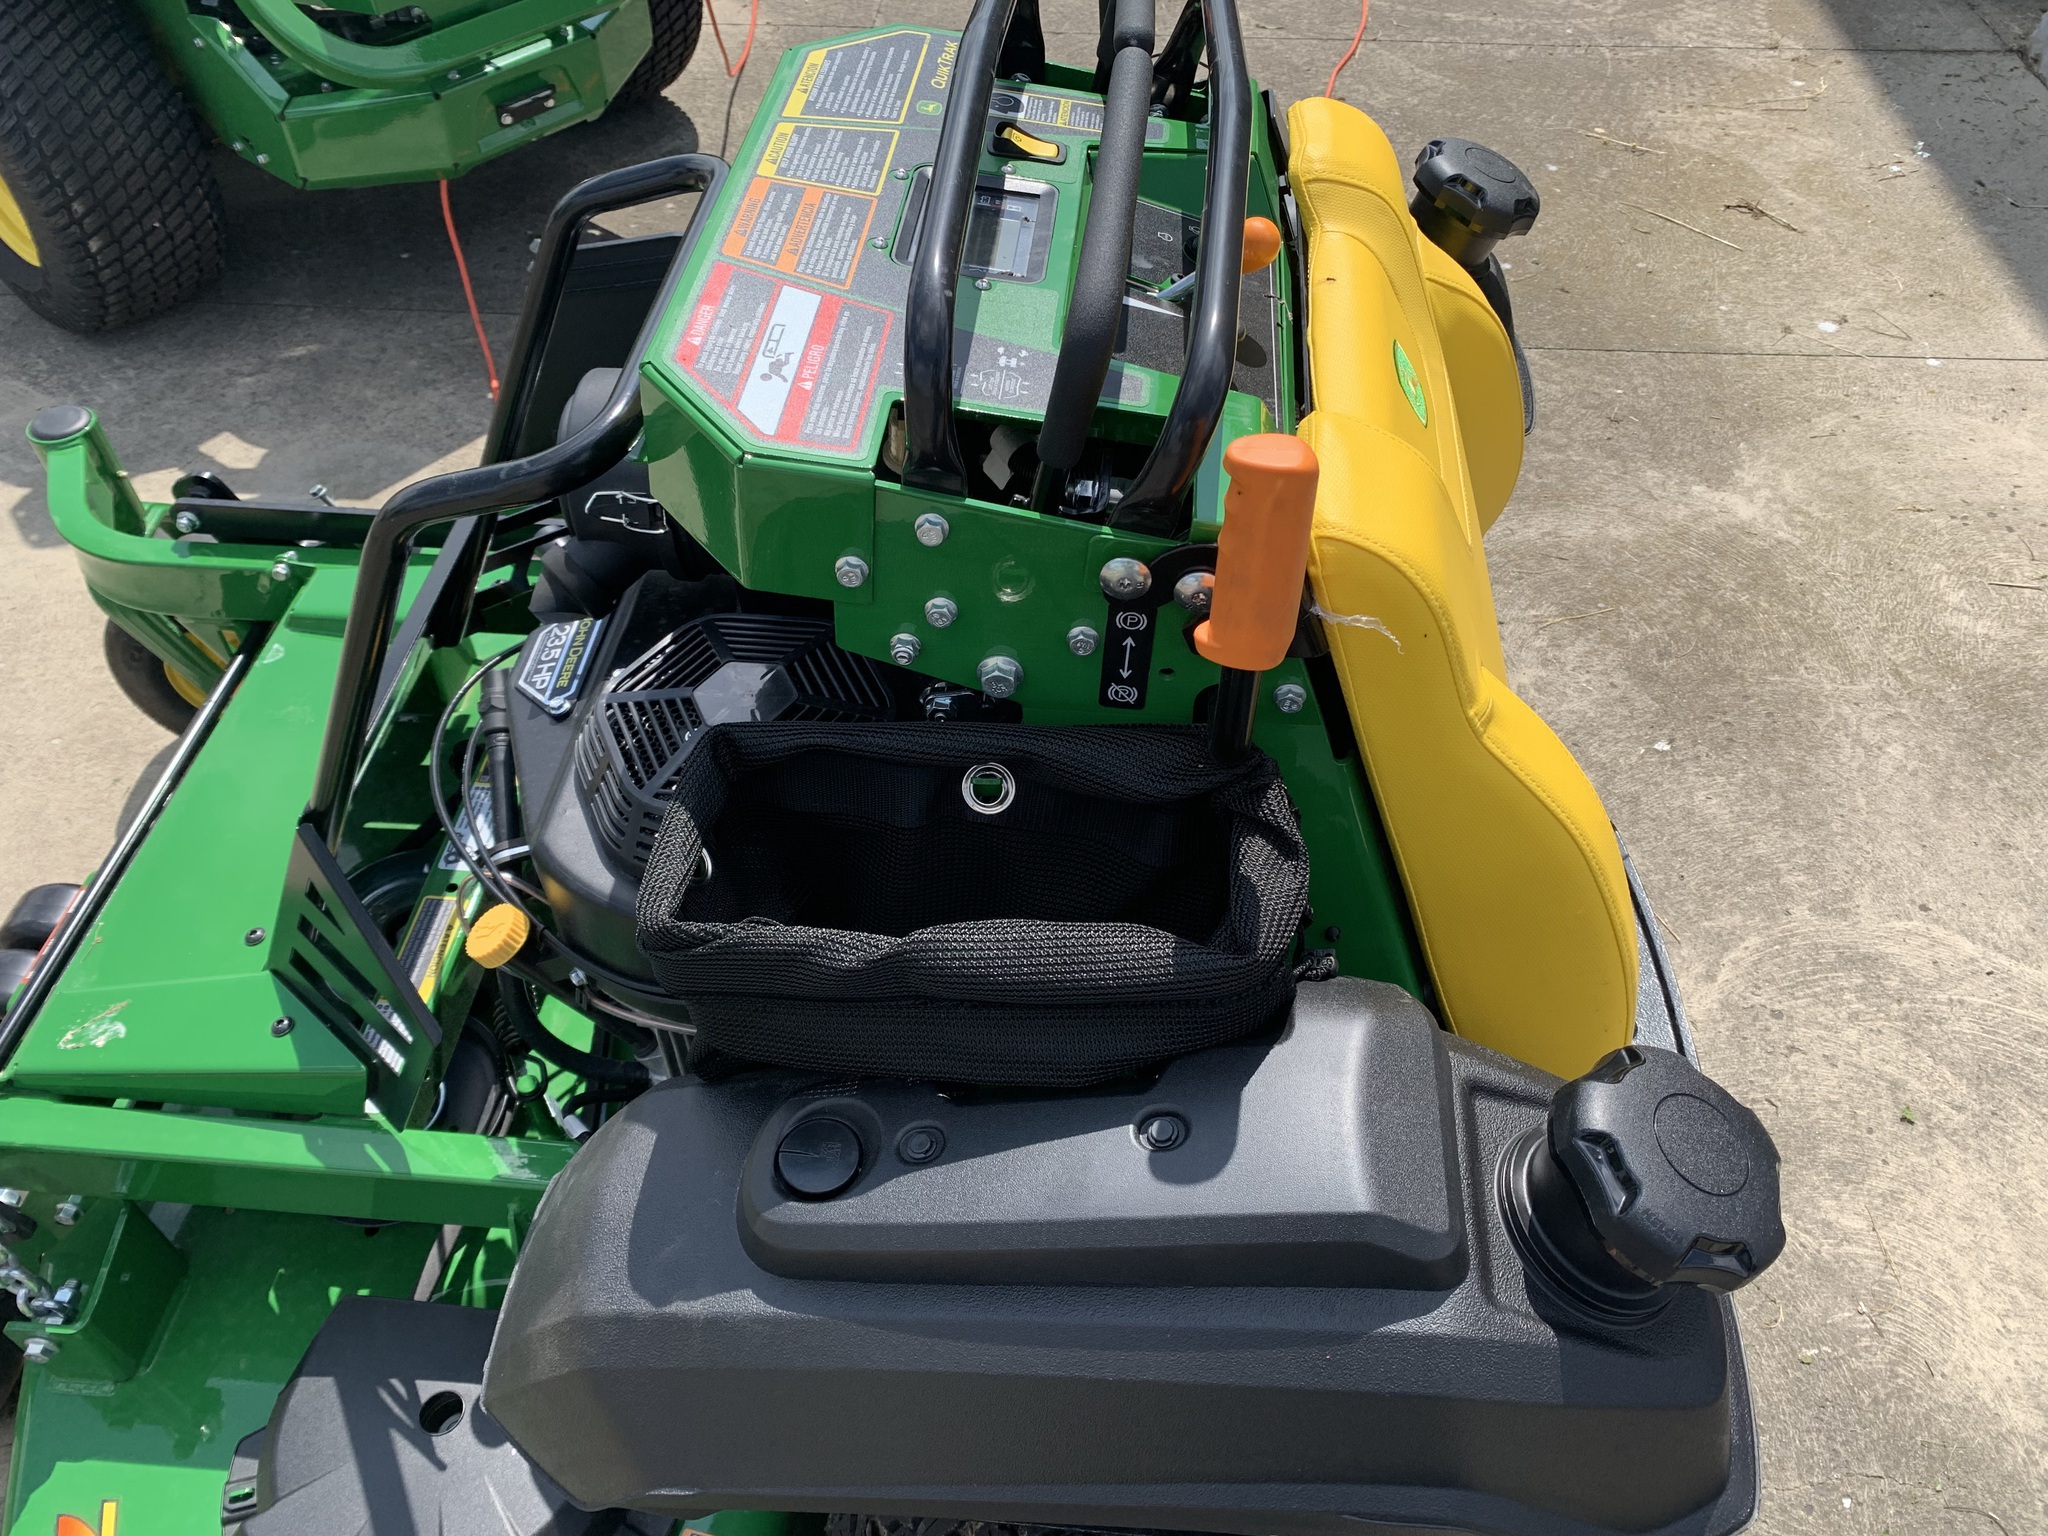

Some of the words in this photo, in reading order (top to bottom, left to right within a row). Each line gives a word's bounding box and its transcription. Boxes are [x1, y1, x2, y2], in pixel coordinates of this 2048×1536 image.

[931, 40, 958, 89] QUIKTRAK
[768, 131, 790, 158] CAUTION
[736, 198, 761, 229] WARNING
[789, 203, 816, 249] ADVERTENCIA
[690, 304, 716, 335] DANGER
[801, 344, 825, 379] PELIGRO
[531, 662, 557, 690] HP
[556, 646, 583, 688] DEERE
